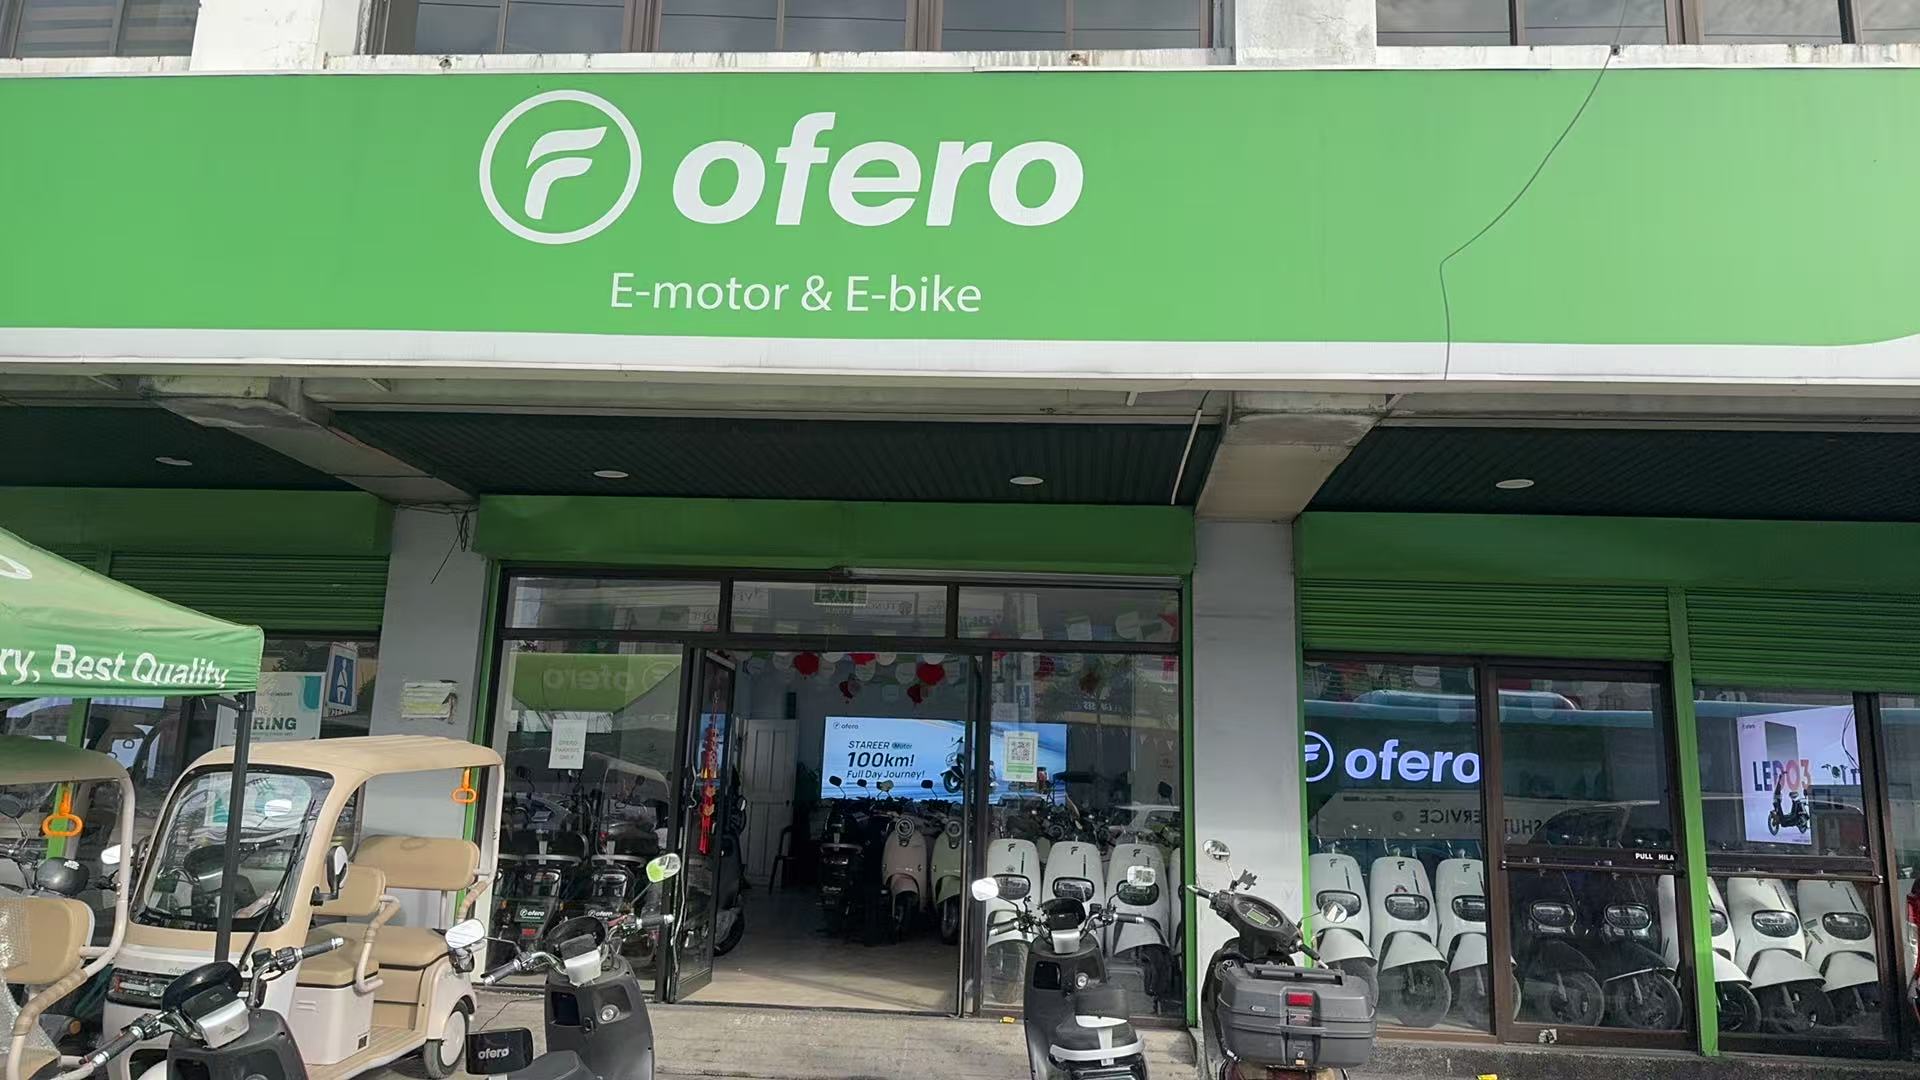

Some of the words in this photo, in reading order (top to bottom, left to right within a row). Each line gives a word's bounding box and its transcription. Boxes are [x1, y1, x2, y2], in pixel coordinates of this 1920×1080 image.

[673, 112, 1083, 227] ofero
[610, 273, 789, 312] E-motor
[801, 275, 833, 312] &
[846, 275, 982, 313] E-bike
[818, 586, 865, 601] EXIT
[51, 644, 126, 682] Best
[131, 652, 229, 688] Quality
[848, 740, 890, 750] STAREER
[848, 751, 915, 768] 100km!
[1344, 739, 1481, 784] ofero
[846, 770, 864, 779] Full
[865, 770, 882, 779] Day
[884, 770, 925, 780] Journey!
[1635, 852, 1653, 860] PULL
[1658, 853, 1675, 861] HILA
[478, 1047, 510, 1060] ofero
